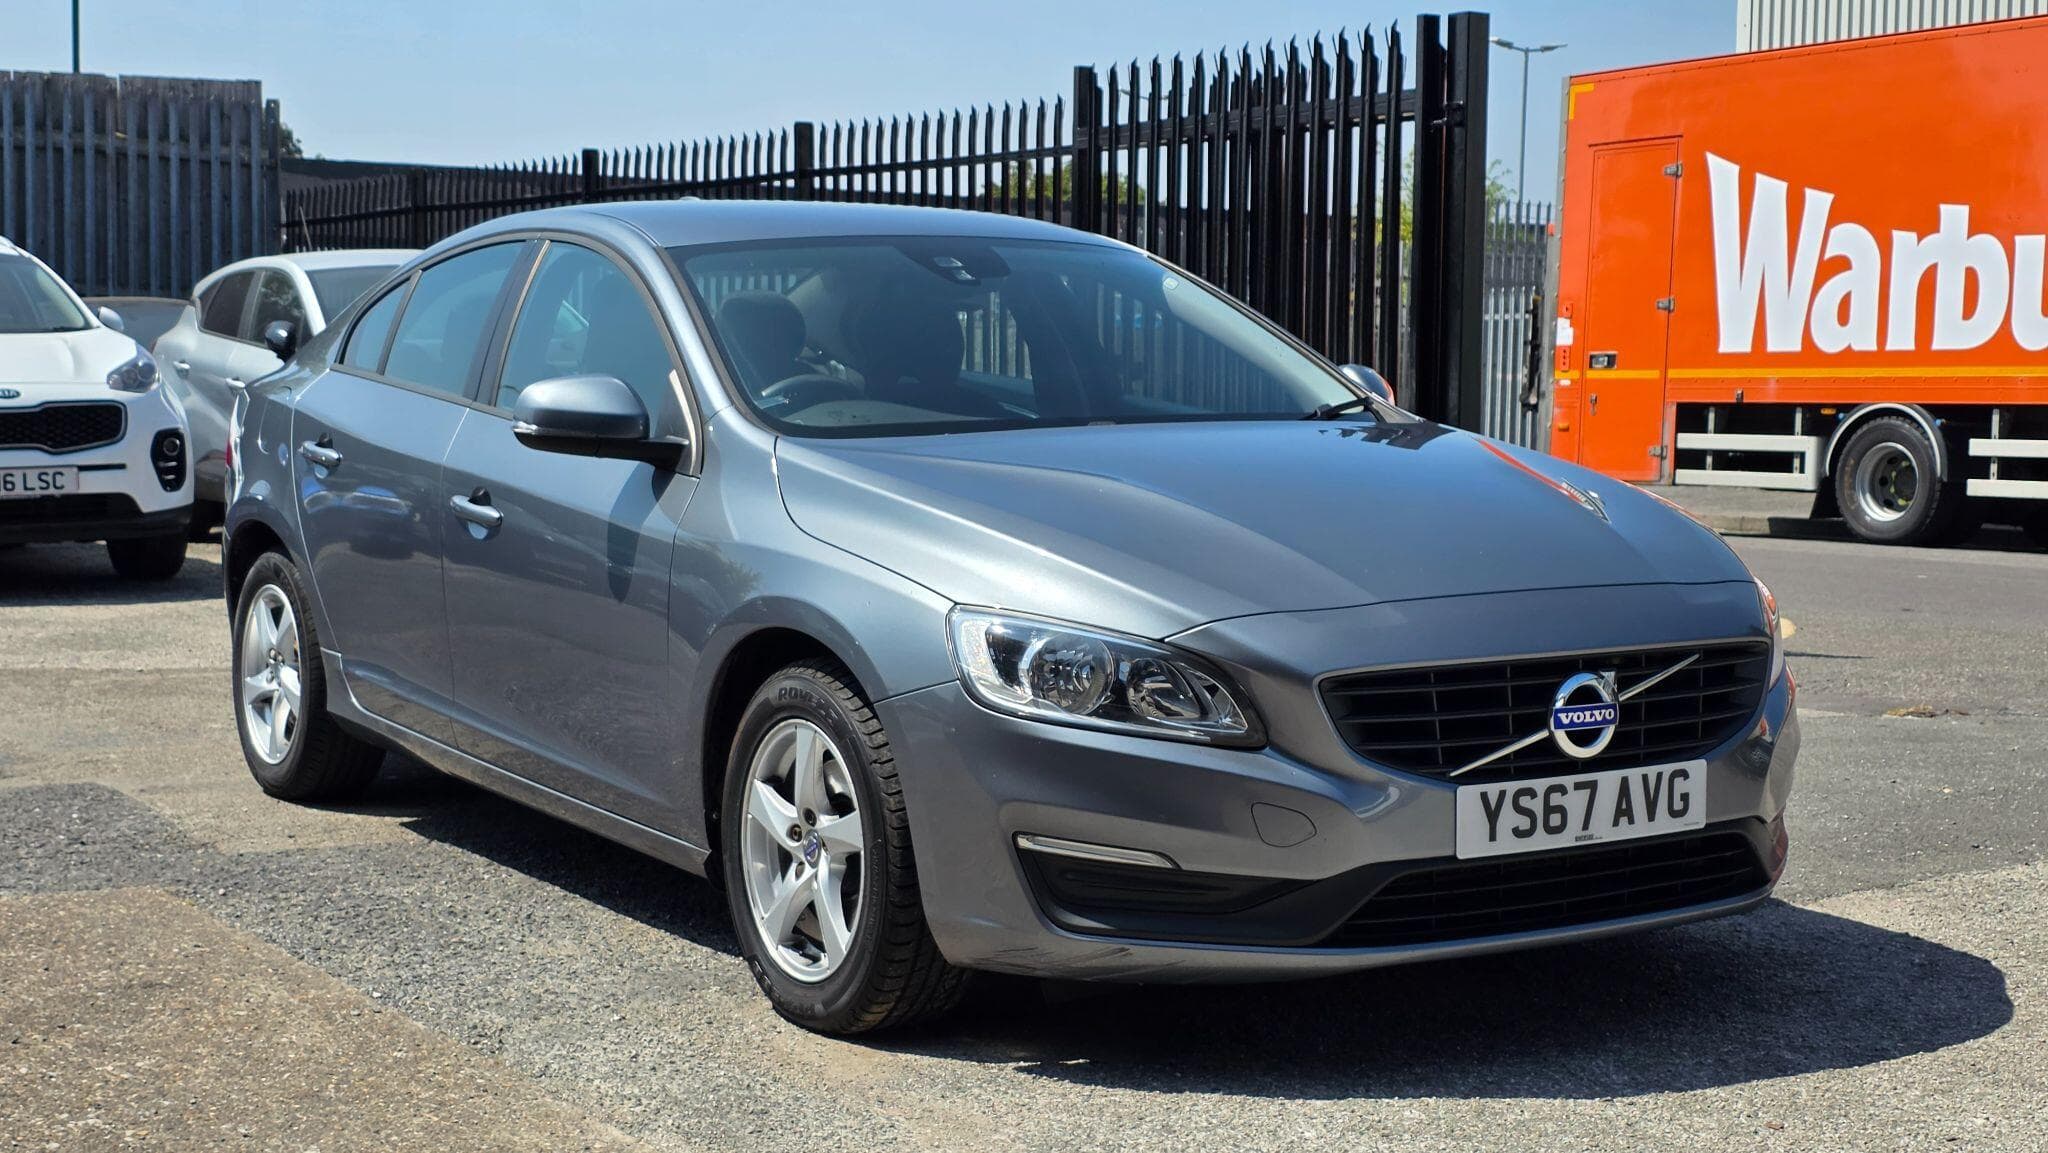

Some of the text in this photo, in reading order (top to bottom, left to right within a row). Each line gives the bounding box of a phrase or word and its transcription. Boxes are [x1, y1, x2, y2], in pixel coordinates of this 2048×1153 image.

[0, 471, 65, 491] 6 LSC
[1558, 708, 1615, 725] VOLVO
[1480, 769, 1690, 842] YS67 AVG
